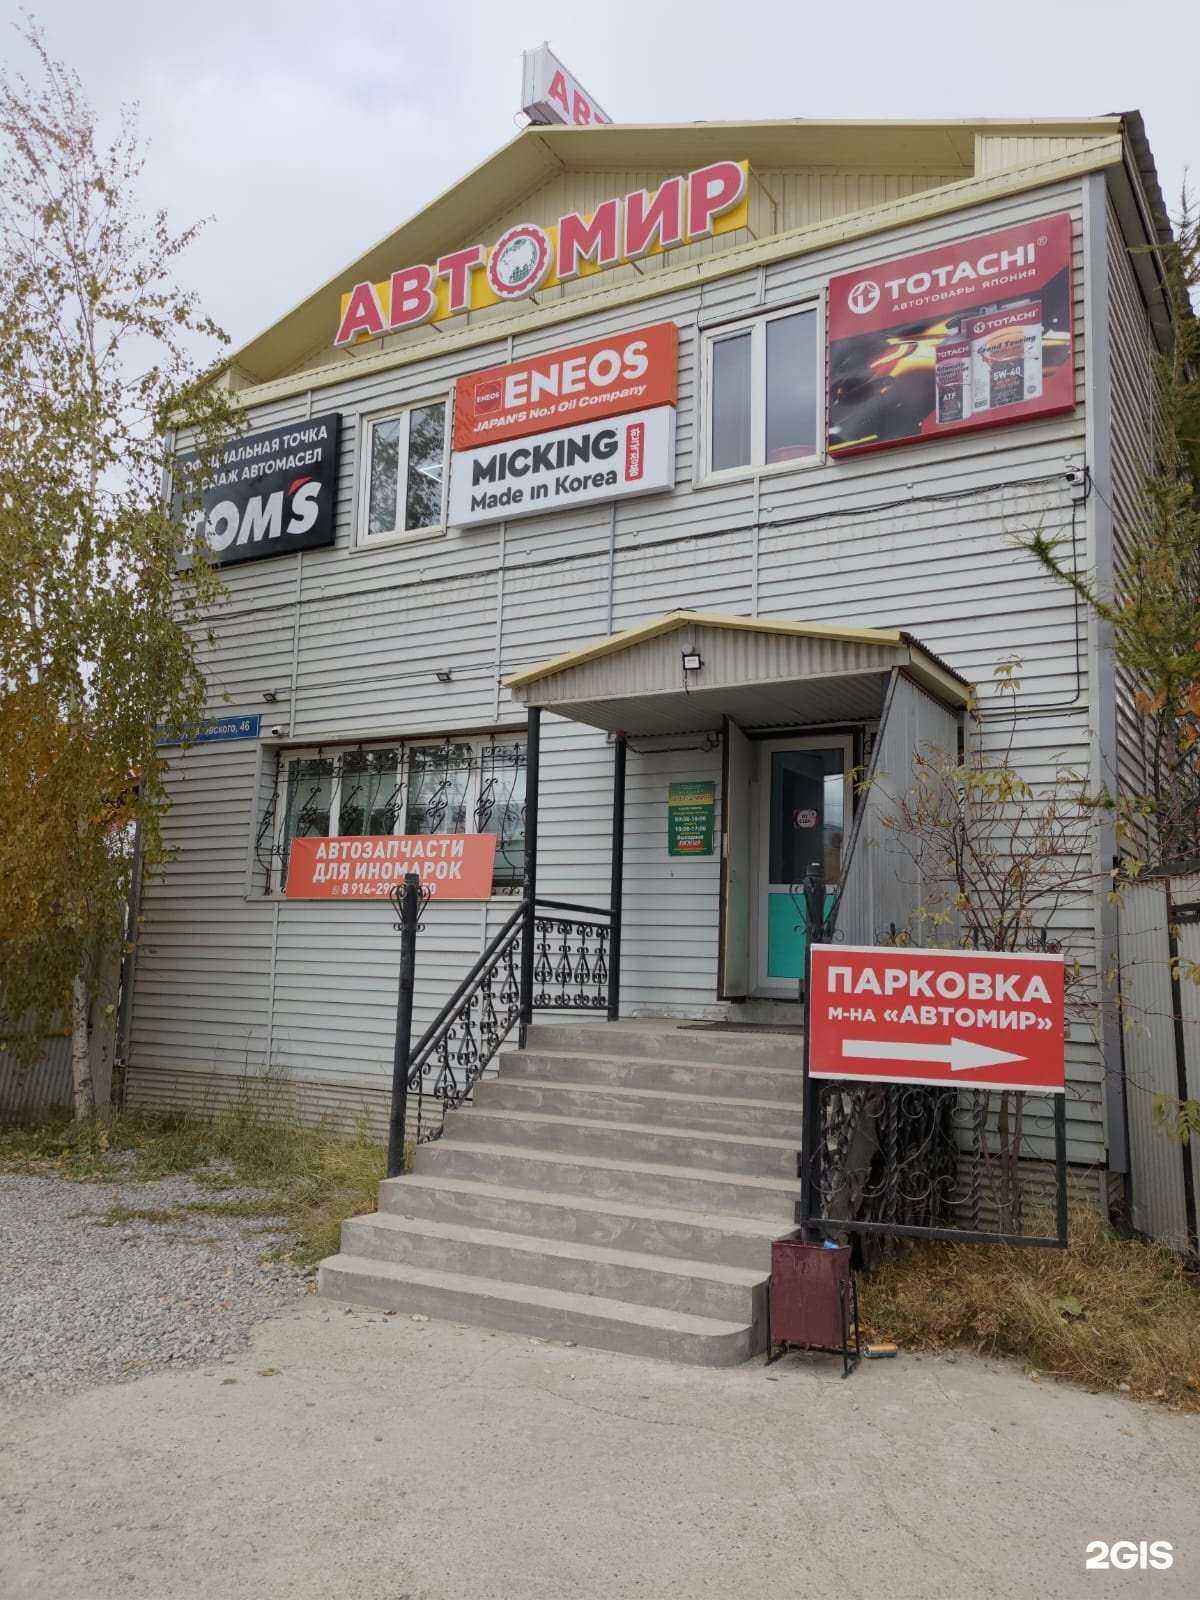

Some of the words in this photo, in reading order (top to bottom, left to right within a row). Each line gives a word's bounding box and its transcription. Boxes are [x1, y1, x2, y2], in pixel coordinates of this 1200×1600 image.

[333, 160, 747, 348] АВТОМИР
[892, 285, 976, 312] АВТОТОВАРЫ
[982, 268, 1037, 289] ЯПОНИЯ
[504, 340, 649, 409] ENEOS
[578, 385, 647, 408] Company
[282, 425, 328, 449] ТОЧКА
[242, 447, 322, 483] АВТОМАСЕЛ
[471, 429, 619, 487] MICKING
[470, 487, 524, 513] Made
[530, 481, 549, 501] in
[555, 469, 618, 496] Korea
[315, 839, 465, 860] АВТОЗАПЧАСТИ
[312, 862, 350, 883] ДЛЯ
[355, 861, 464, 880] ИНОМАРОК
[827, 965, 1053, 1004] ПАРКОВКА
[883, 1004, 1053, 1031] «АВТОМИР»
